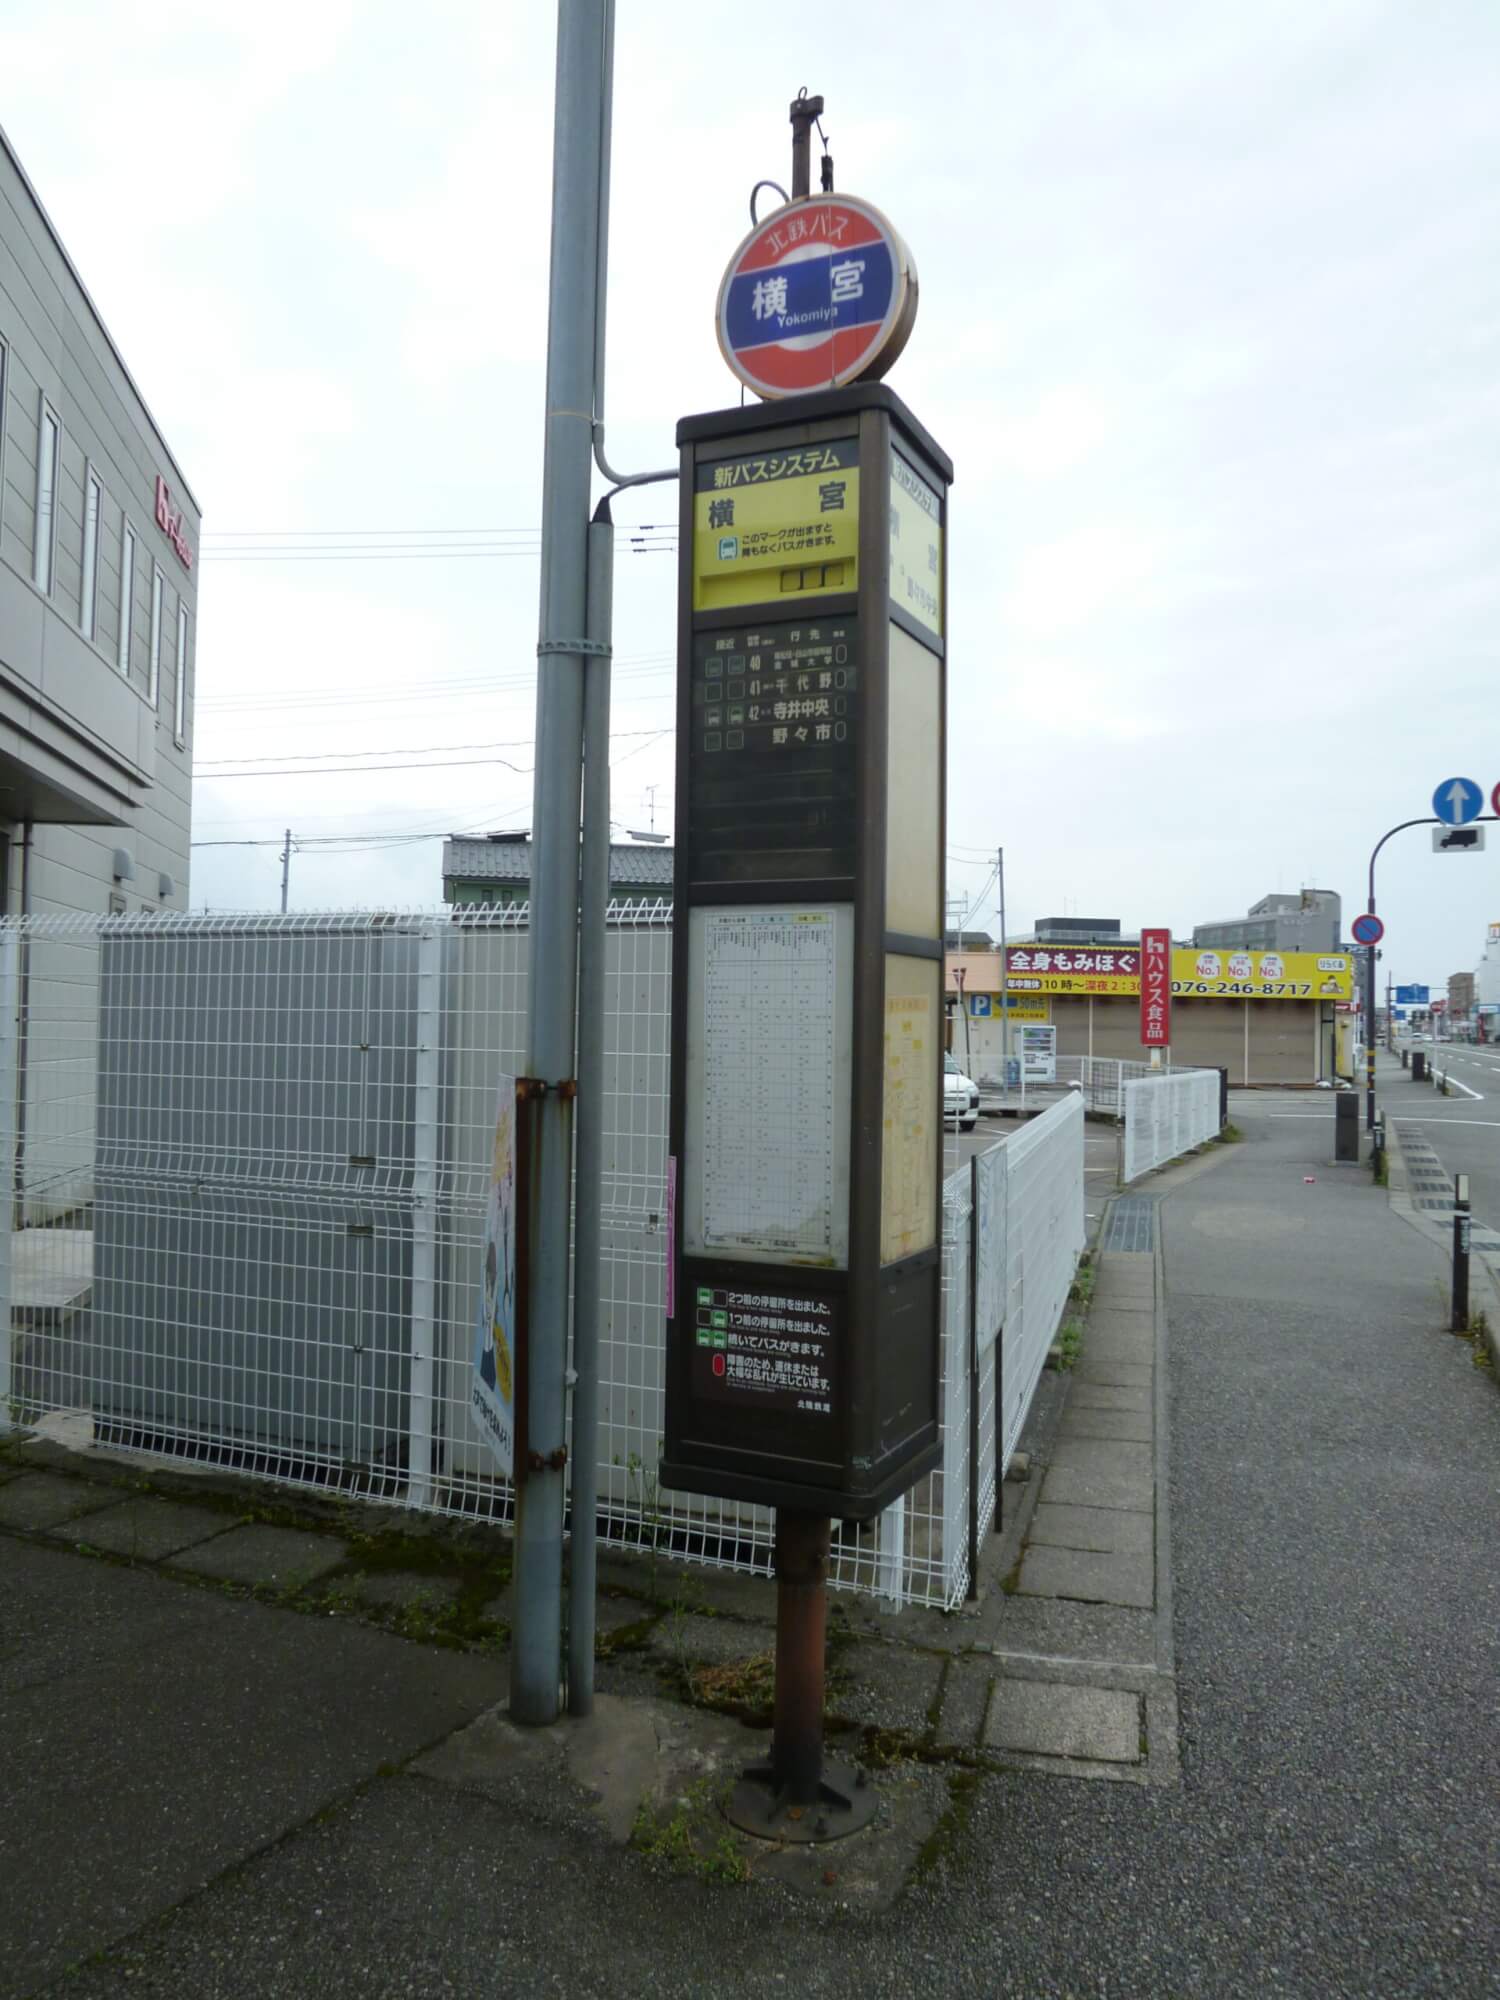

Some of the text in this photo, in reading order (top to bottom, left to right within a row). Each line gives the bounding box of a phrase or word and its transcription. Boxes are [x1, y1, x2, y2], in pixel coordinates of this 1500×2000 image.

[766, 213, 849, 257] 北鉄バス
[752, 260, 865, 320] 横宮
[777, 306, 838, 328] Yokomiya
[714, 448, 840, 488] 新バスシステム
[709, 480, 846, 529] 横宮
[749, 679, 760, 696] 41
[775, 671, 832, 694] 千代野
[773, 697, 830, 720] 寺井中央
[772, 722, 832, 744] 野々市
[1009, 950, 1136, 973] 全身もみほぐ
[1196, 964, 1221, 976] No.1
[1228, 965, 1252, 977] No.1
[1259, 966, 1283, 977] No.1
[1147, 954, 1164, 1039] ハウス食品
[1171, 981, 1312, 996] 076-246-8717
